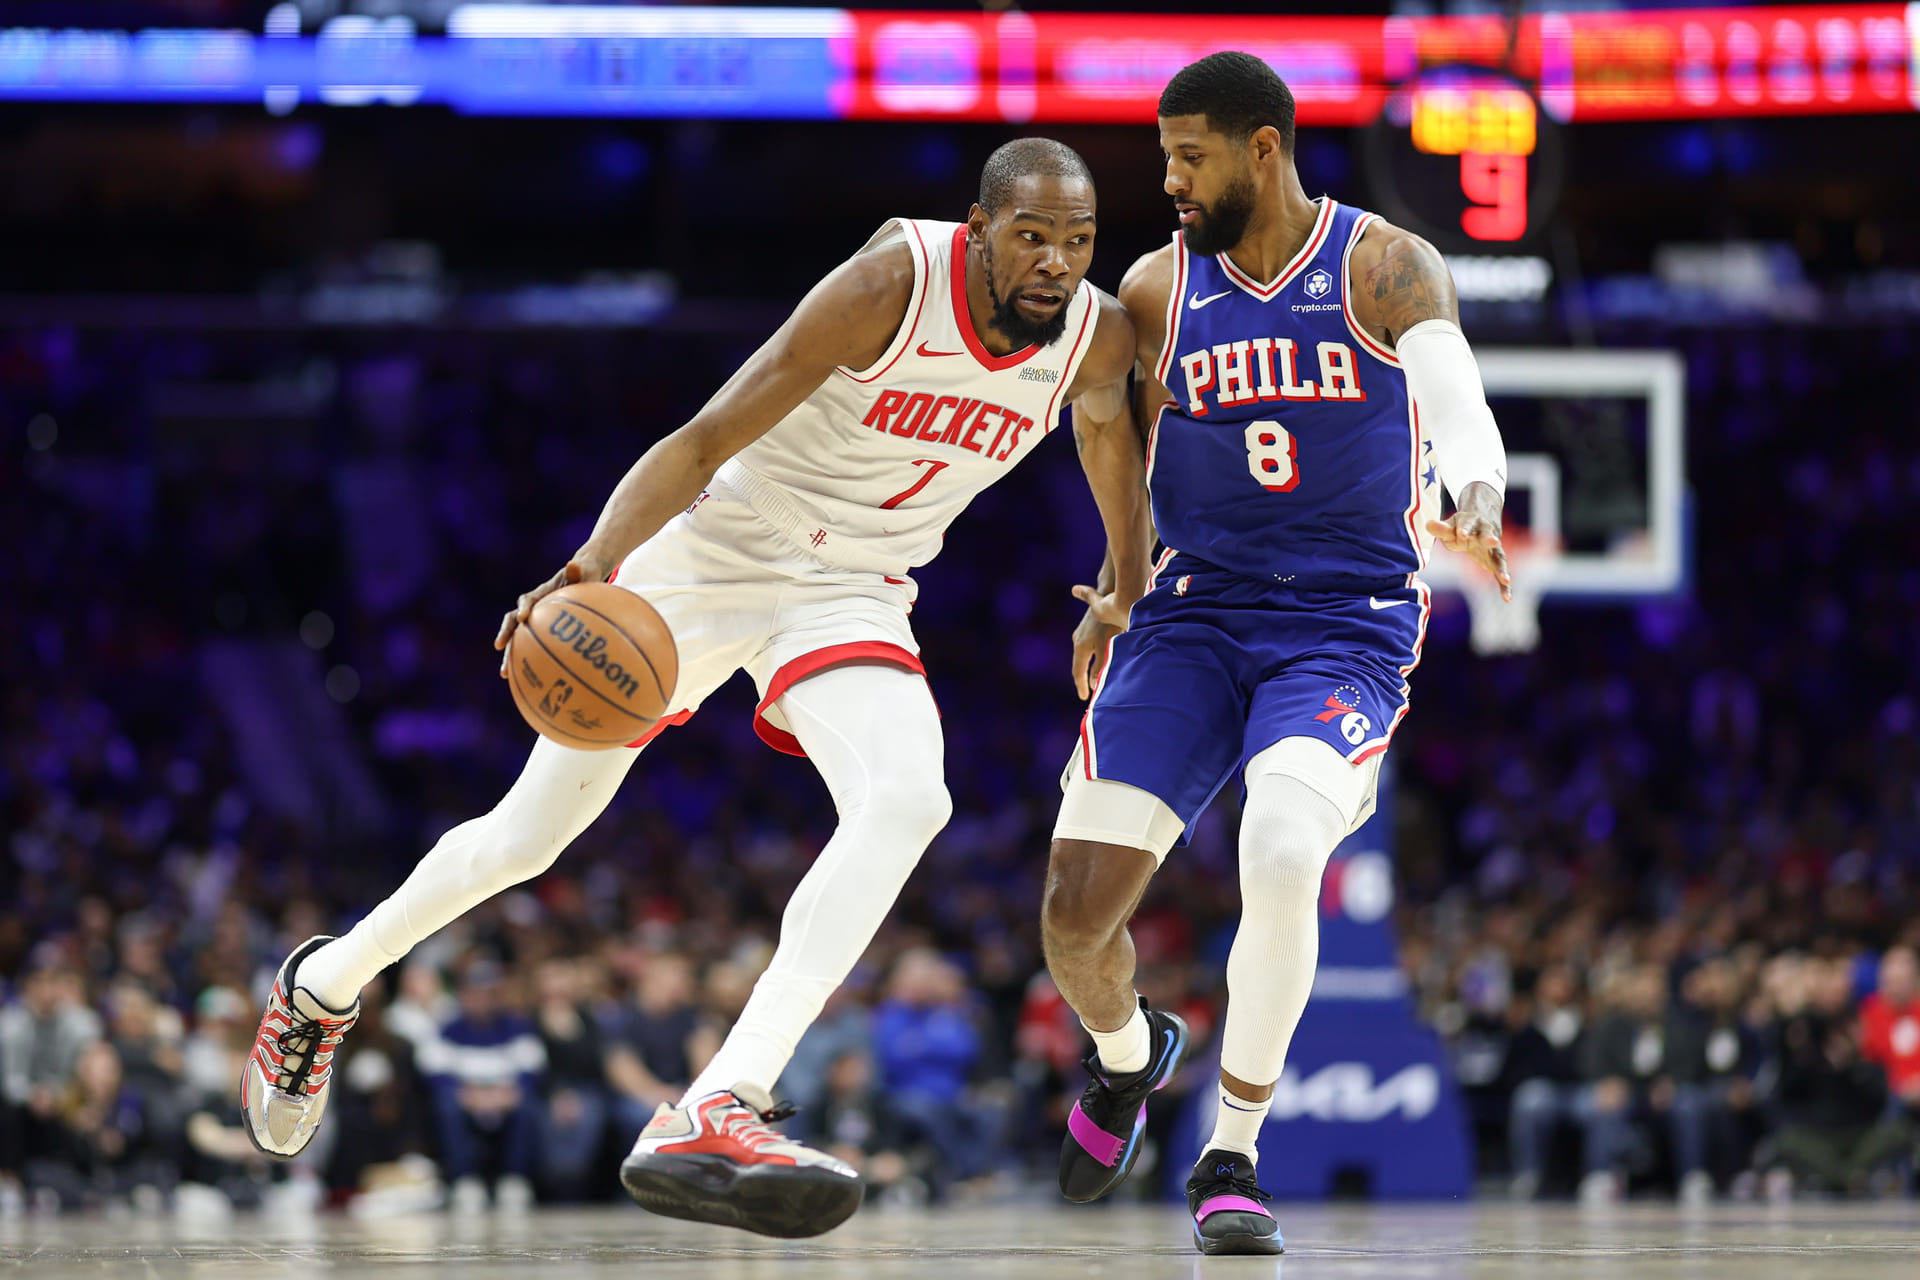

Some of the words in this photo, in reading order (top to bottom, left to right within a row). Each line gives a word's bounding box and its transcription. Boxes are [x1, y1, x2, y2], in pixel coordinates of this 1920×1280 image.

[1291, 303, 1342, 313] crypto.com
[1179, 337, 1367, 418] PHILA
[861, 389, 1034, 462] ROCKETS
[1244, 420, 1301, 493] 8
[879, 459, 950, 510] 7
[549, 608, 640, 699] Wilson
